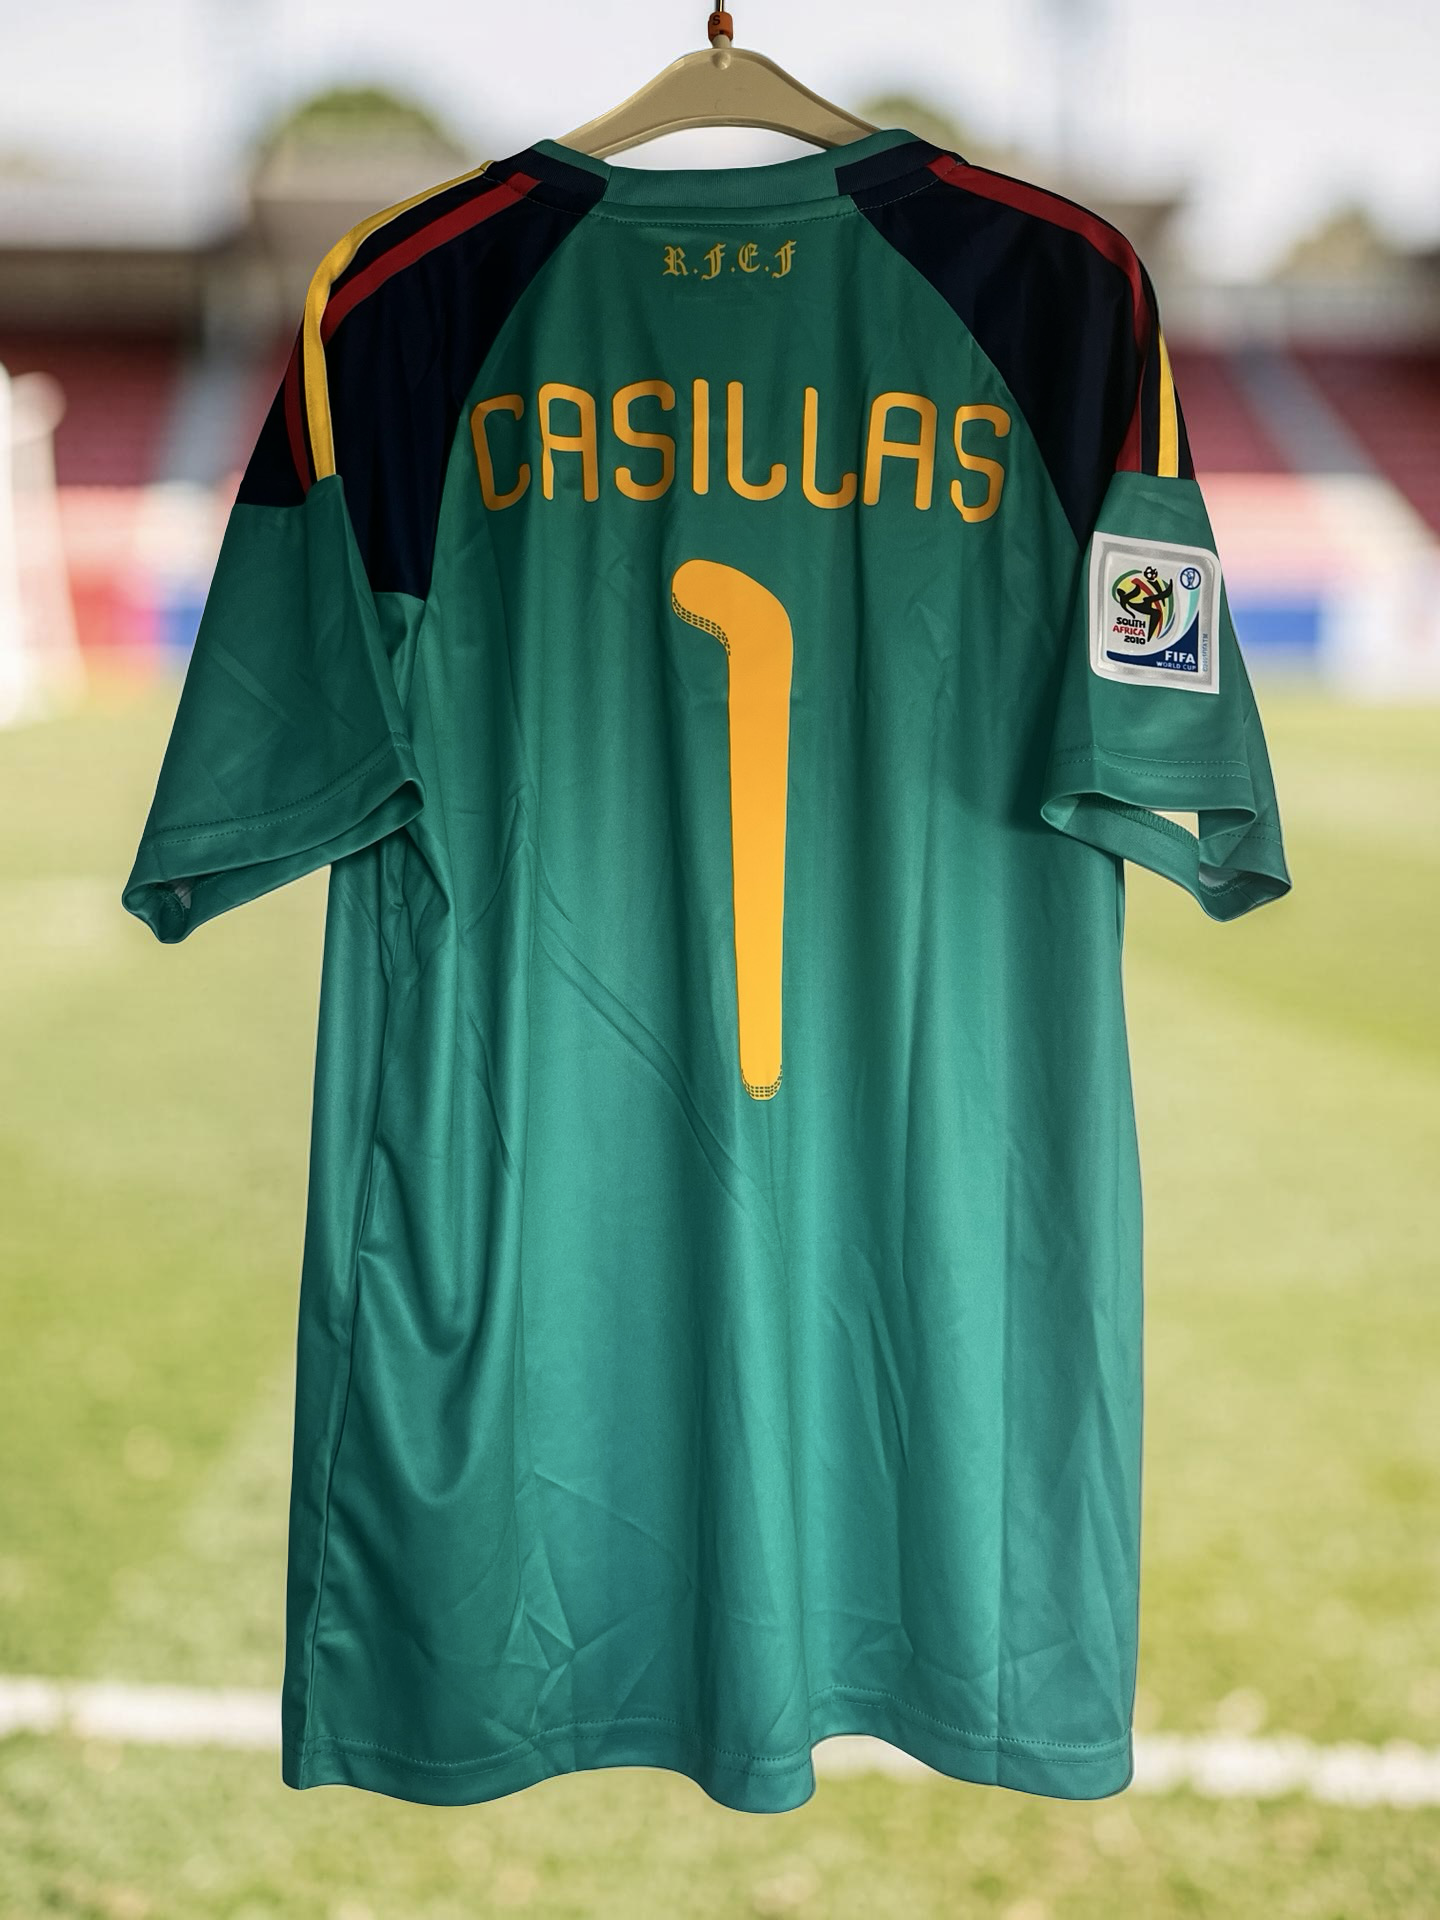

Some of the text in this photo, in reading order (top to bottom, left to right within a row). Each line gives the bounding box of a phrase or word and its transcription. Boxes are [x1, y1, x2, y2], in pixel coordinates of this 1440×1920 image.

[470, 378, 1011, 524] CASILLAS
[1116, 617, 1145, 628] SOUTH
[1113, 625, 1145, 637] AFRICA
[1124, 636, 1145, 645] 2010
[1165, 651, 1195, 664] FIFA
[1157, 661, 1197, 671] WORLD CUP
[672, 559, 794, 1101] 1
